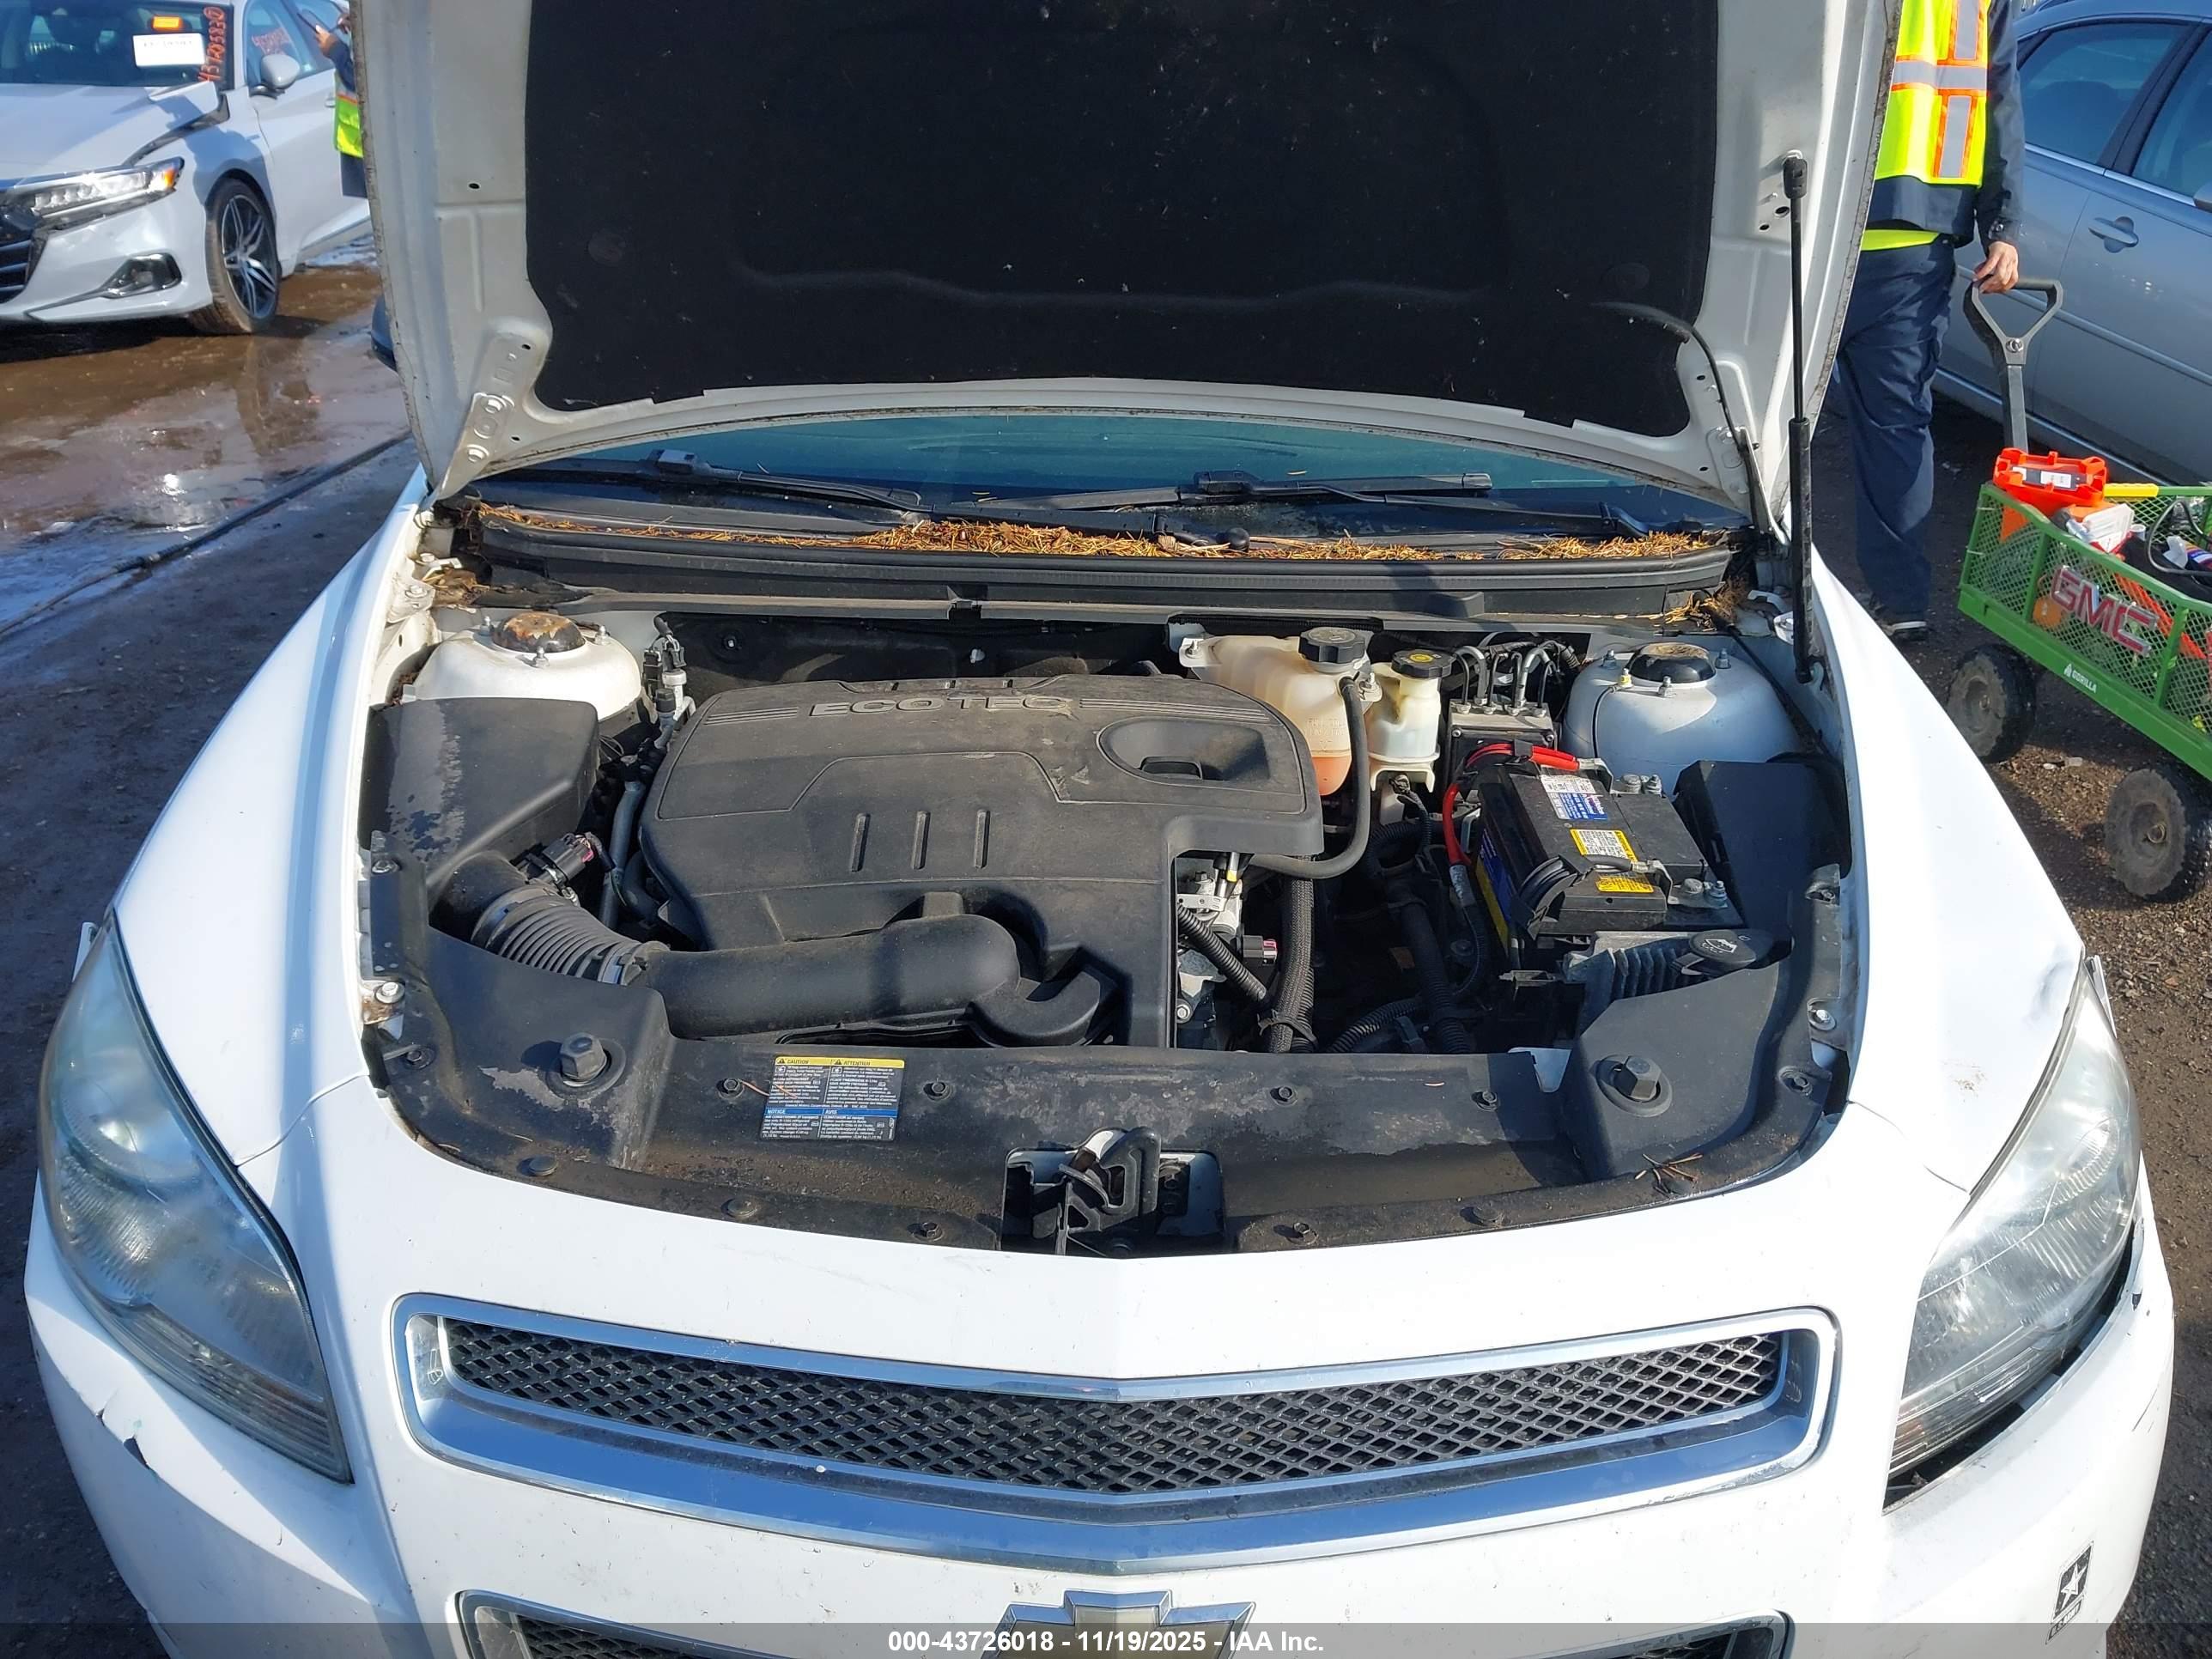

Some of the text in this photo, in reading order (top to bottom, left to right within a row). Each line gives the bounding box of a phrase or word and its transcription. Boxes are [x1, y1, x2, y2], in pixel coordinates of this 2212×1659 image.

[2051, 565, 2159, 656] GMC
[2071, 670, 2098, 694] GORILLA
[809, 695, 1067, 716] ECOTEC
